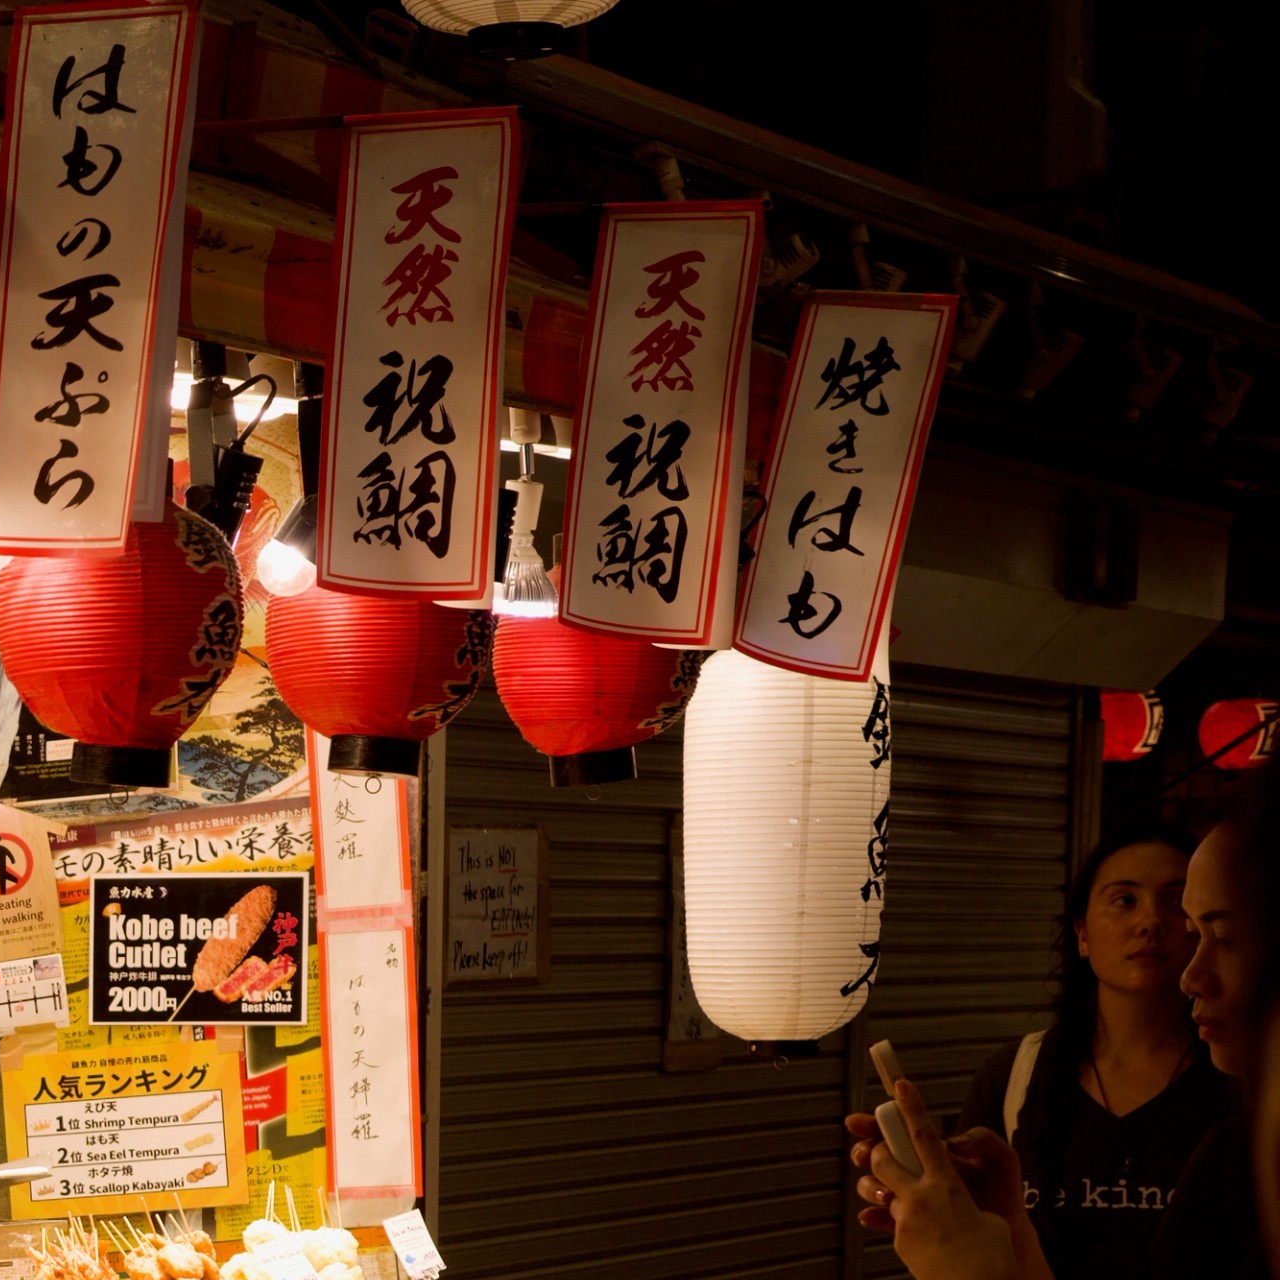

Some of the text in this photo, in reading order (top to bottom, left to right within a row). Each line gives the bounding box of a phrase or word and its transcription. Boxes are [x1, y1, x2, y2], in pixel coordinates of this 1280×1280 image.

[31, 44, 138, 511] はもの天ぷら
[778, 335, 901, 640] 焼きはも
[458, 840, 517, 872] This is NOT
[463, 874, 524, 922] the space for
[2, 909, 44, 925] walking
[109, 913, 239, 941] Kobe beef
[272, 911, 299, 975] 神戸牛
[108, 941, 188, 969] Cutlet
[453, 940, 480, 972] Please
[108, 986, 178, 1013] 2000円
[264, 989, 293, 1002] NO.1
[240, 1002, 293, 1013] Best Seller
[99, 1053, 168, 1067] 自慢の売れ筋商品
[33, 1063, 210, 1101] 人気ランキング
[84, 1101, 118, 1113] えび天
[84, 1118, 126, 1130] Shrimp
[129, 1114, 180, 1127] Tempura
[85, 1133, 120, 1146] はも天
[86, 1152, 108, 1162] Sea
[109, 1149, 127, 1160] Eel
[129, 1146, 180, 1159] Tempura
[87, 1165, 134, 1178] ホタテ焼
[89, 1183, 130, 1195] Scallop
[132, 1177, 185, 1192] Kabayaki
